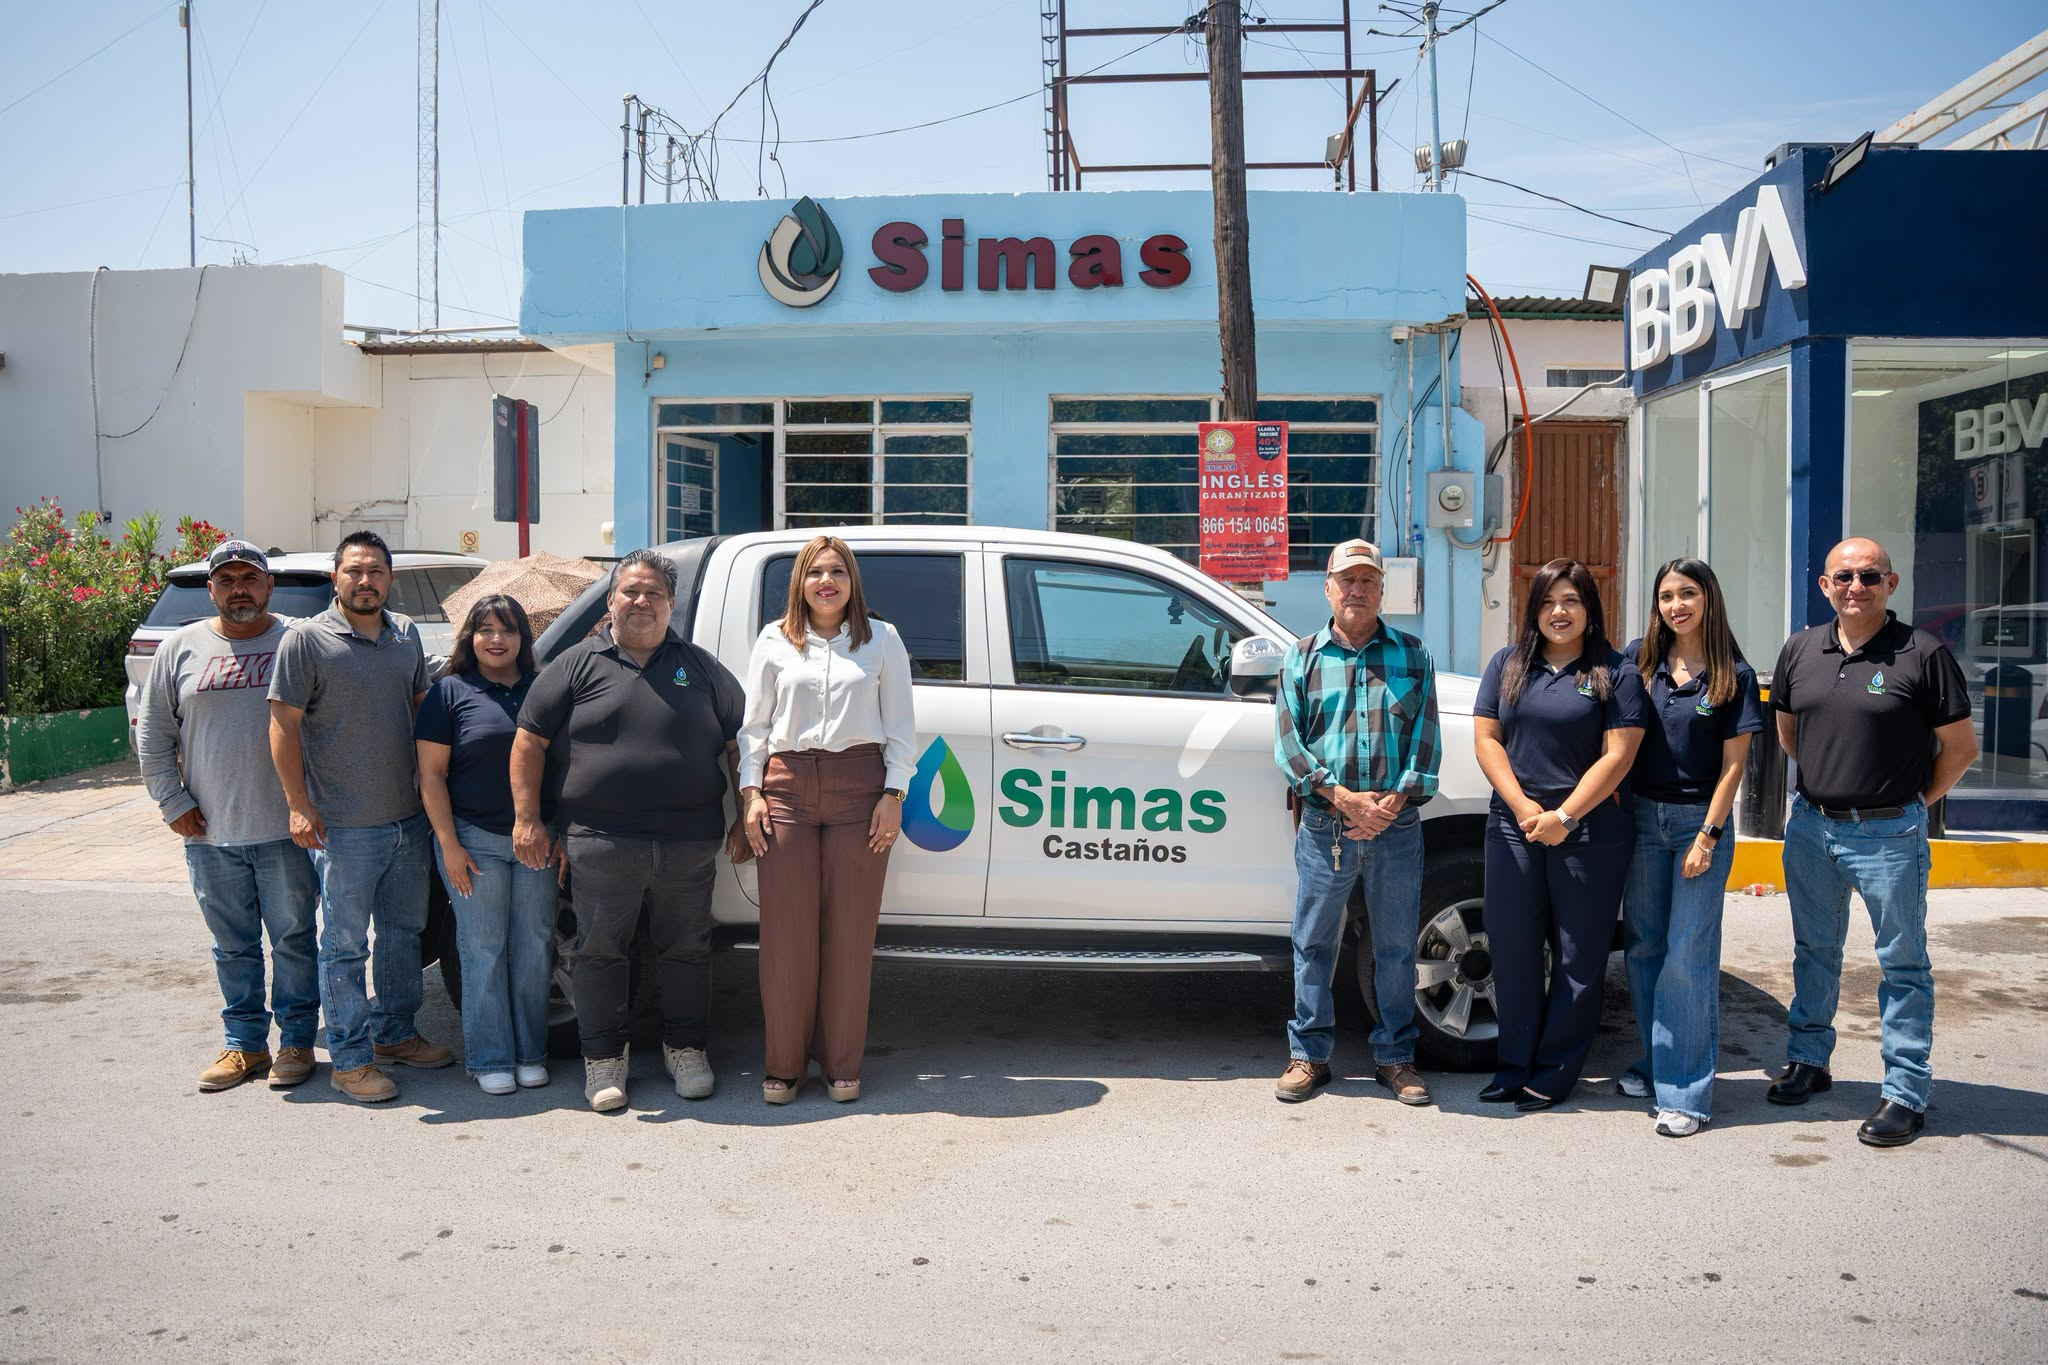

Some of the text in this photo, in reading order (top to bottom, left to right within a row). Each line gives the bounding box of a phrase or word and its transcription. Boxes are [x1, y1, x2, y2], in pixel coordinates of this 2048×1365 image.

[867, 218, 1190, 293] Simas
[1630, 185, 1806, 371] BBVA
[1258, 437, 1281, 446] 40%
[1954, 392, 2048, 461] BBV
[1202, 471, 1285, 489] INGLÉS
[1202, 491, 1286, 500] GARANTIZADO
[1202, 516, 1285, 534] 866 154 0645
[998, 768, 1228, 835] Simas
[1043, 834, 1187, 864] Castaños
